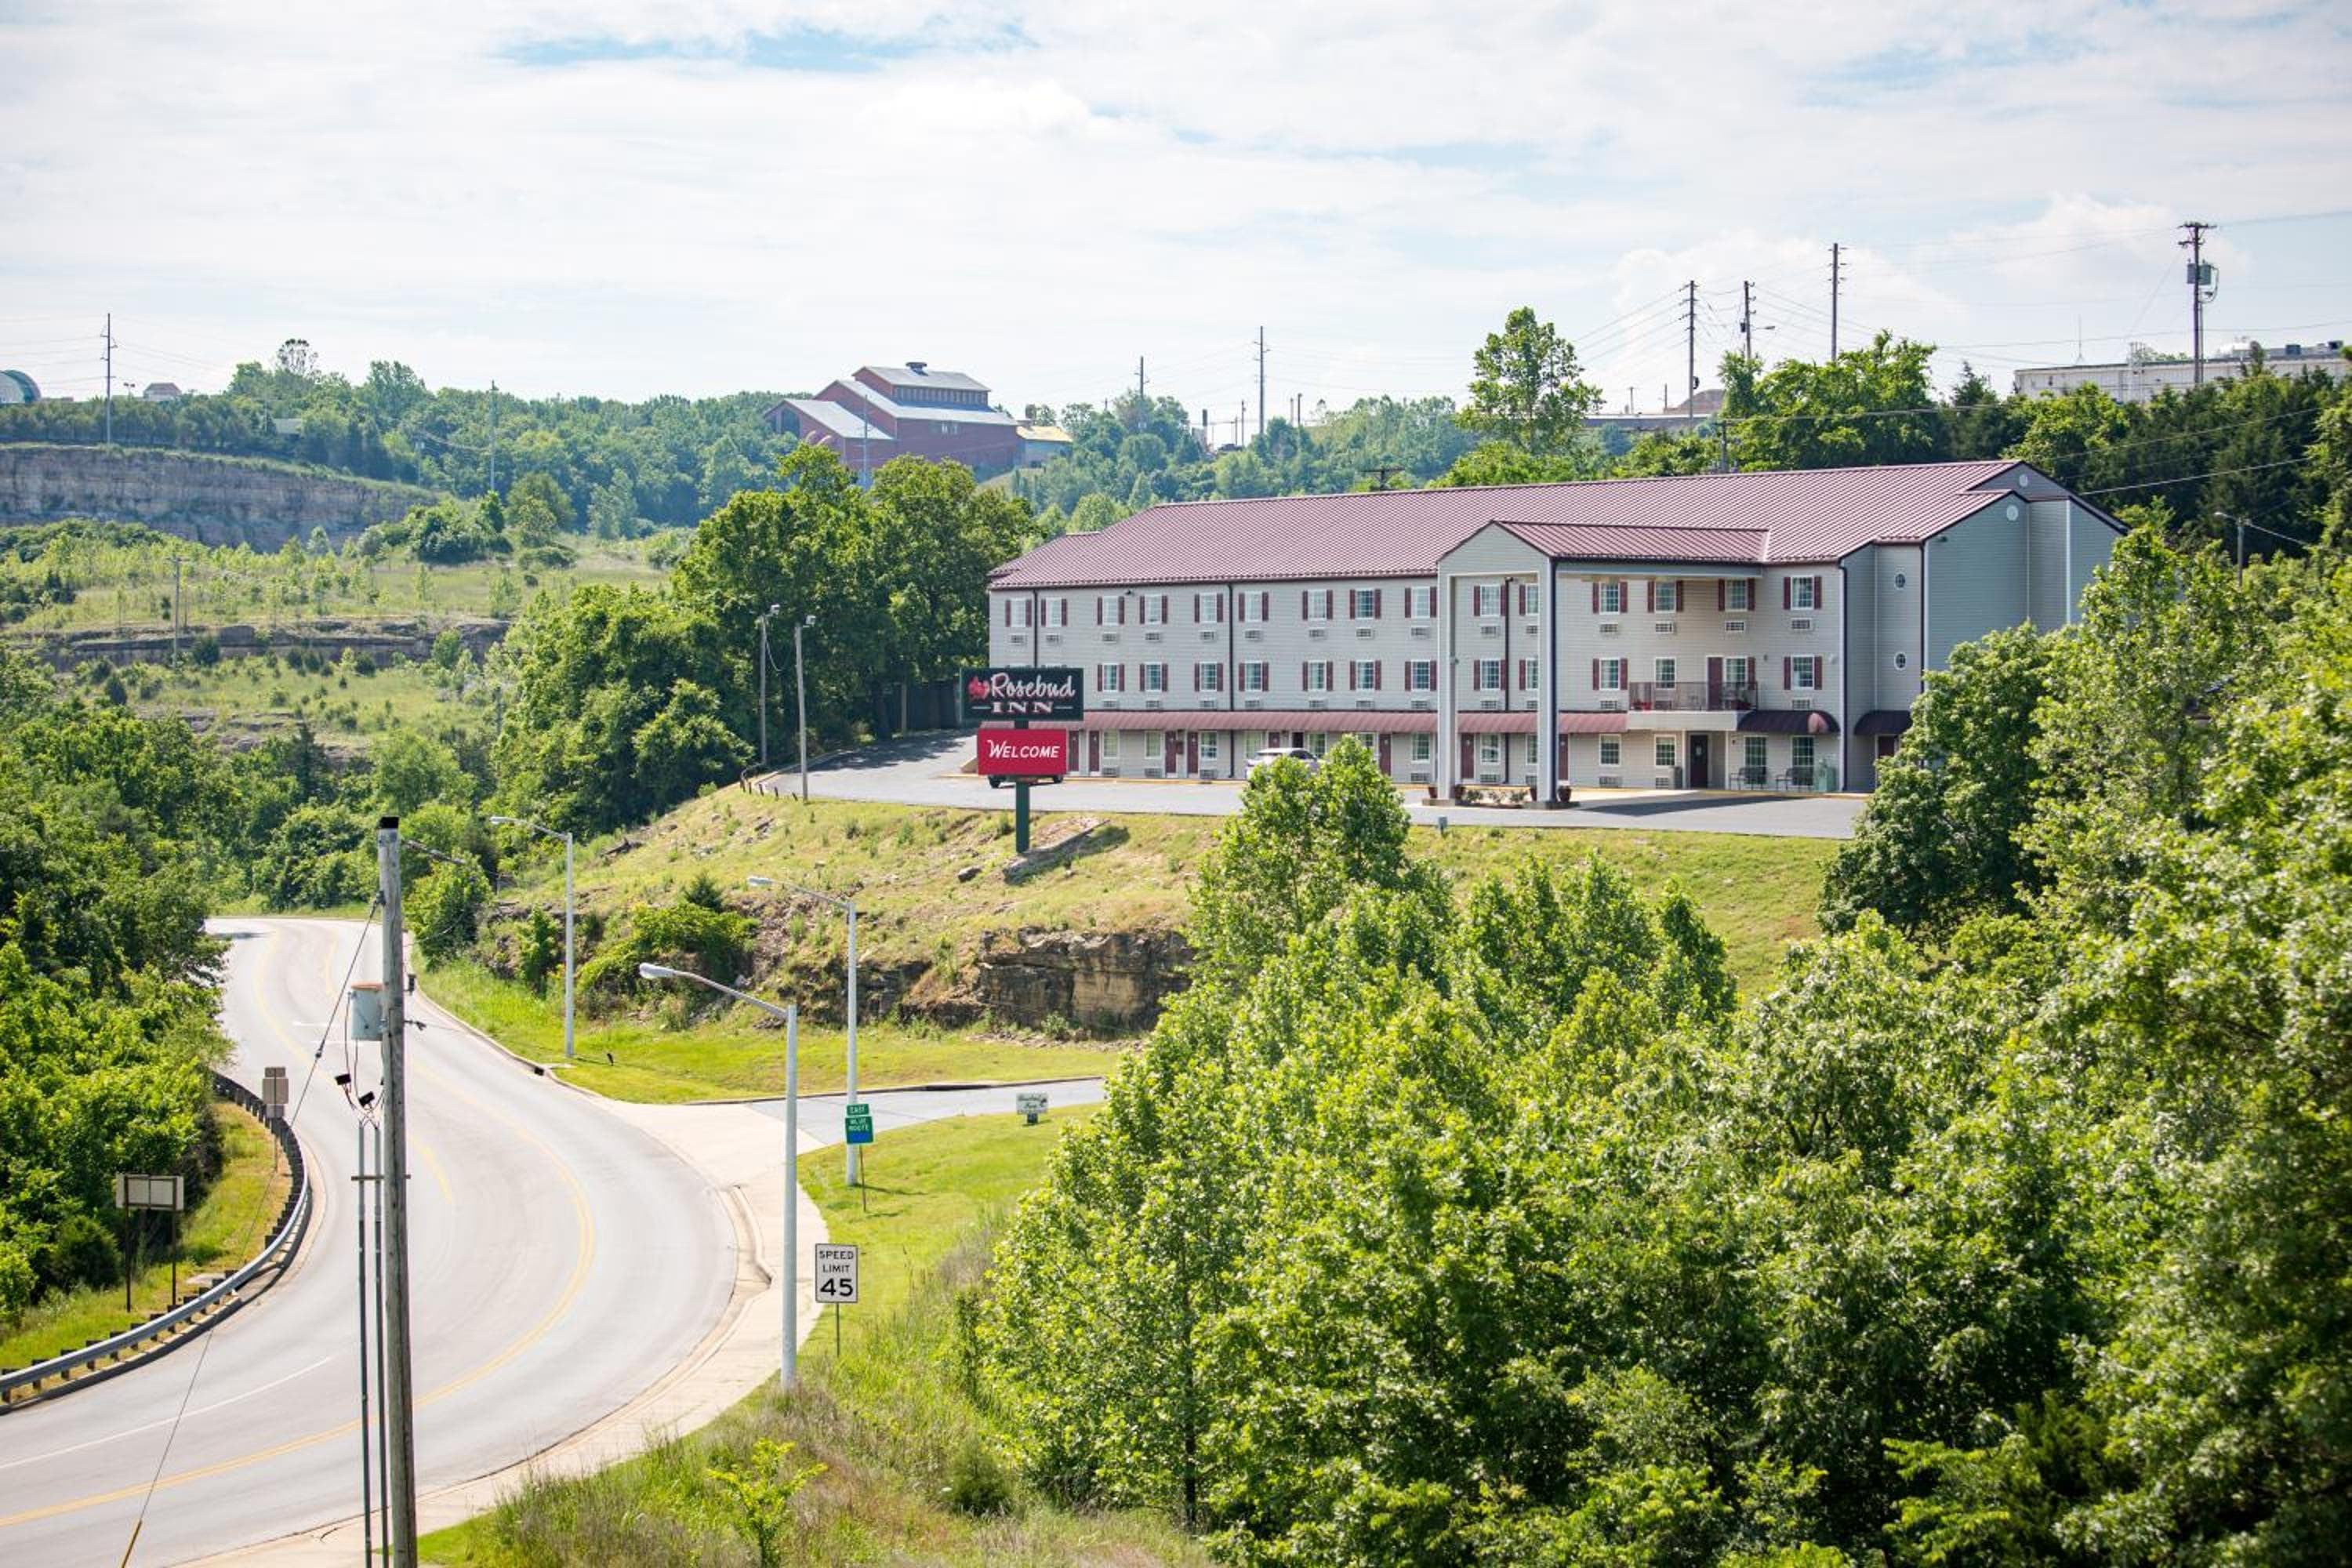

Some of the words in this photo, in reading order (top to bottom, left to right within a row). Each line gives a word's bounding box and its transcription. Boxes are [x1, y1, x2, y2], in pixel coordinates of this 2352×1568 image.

[991, 672, 1076, 698] Rosebud
[993, 701, 1054, 713] INN
[986, 739, 1061, 758] WELCOME
[818, 1250, 854, 1259] SPEED
[820, 1278, 853, 1297] 45
